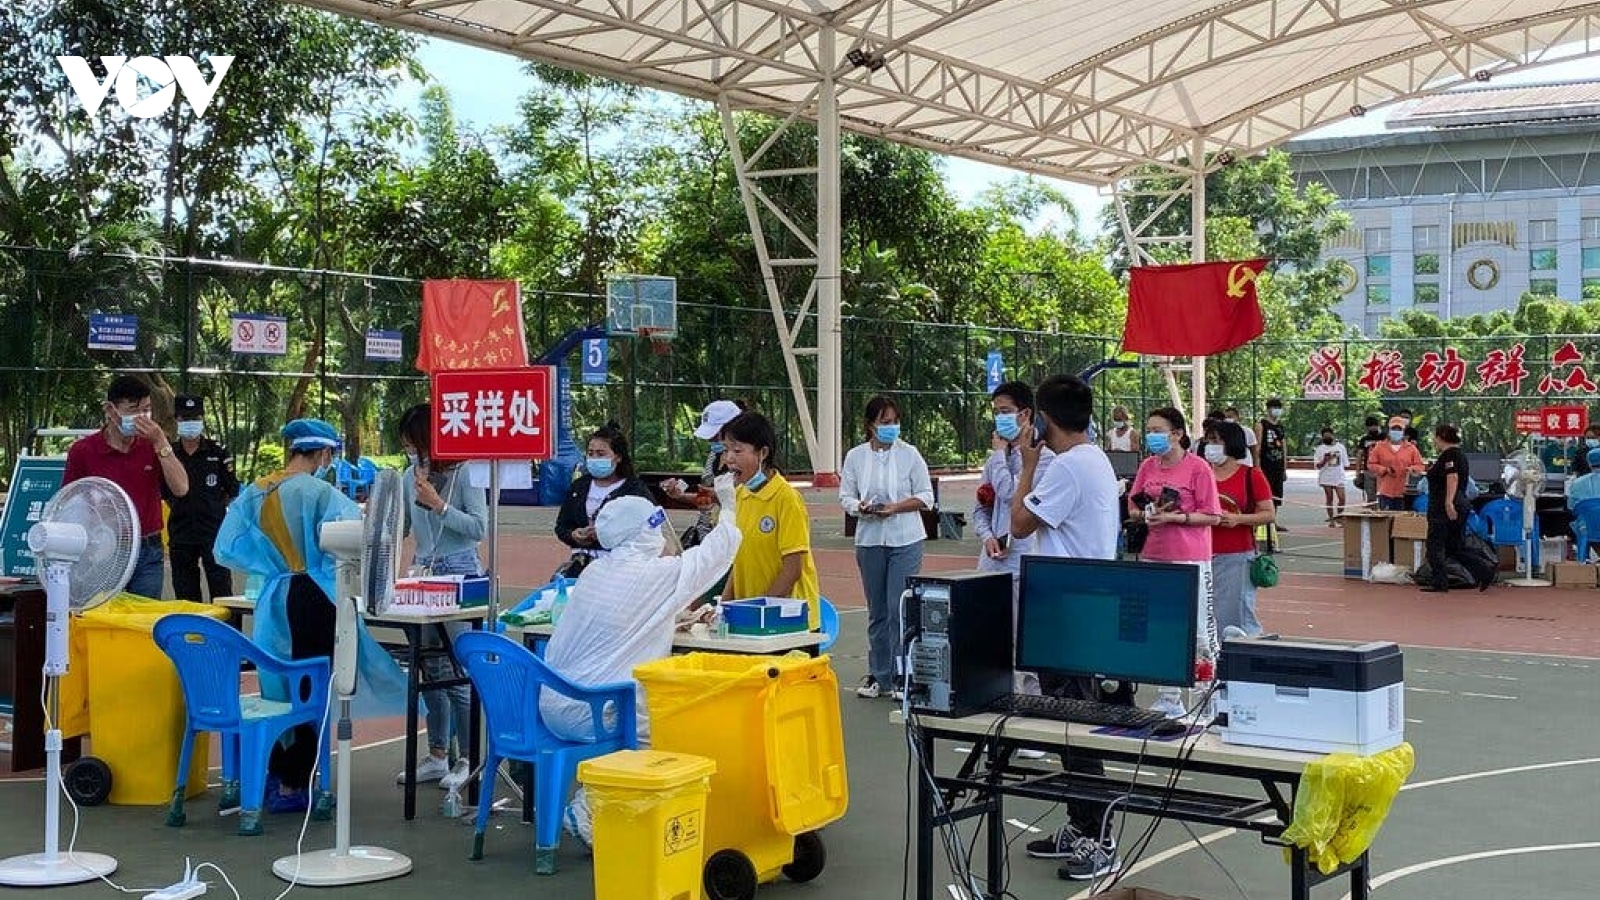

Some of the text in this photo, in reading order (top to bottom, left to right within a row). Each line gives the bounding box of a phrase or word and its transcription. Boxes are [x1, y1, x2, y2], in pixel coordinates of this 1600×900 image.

[588, 338, 603, 368] 5
[990, 361, 999, 382] 4
[440, 389, 540, 438] 采样处
[1546, 412, 1581, 431] 收费
